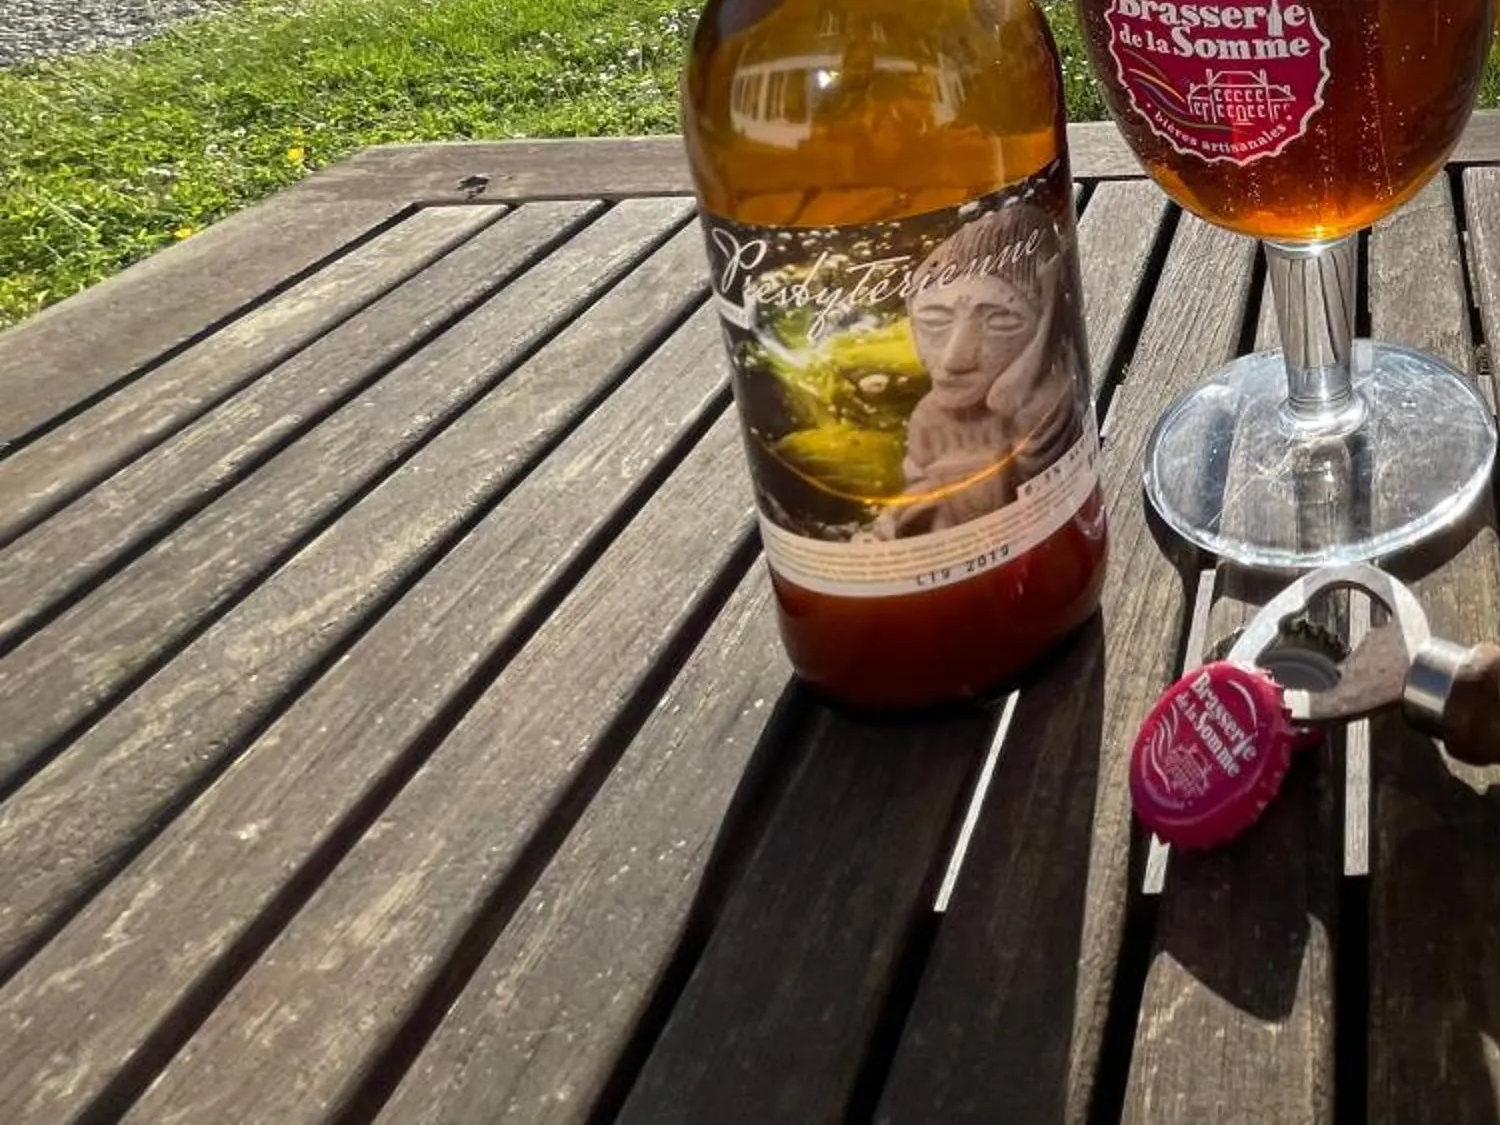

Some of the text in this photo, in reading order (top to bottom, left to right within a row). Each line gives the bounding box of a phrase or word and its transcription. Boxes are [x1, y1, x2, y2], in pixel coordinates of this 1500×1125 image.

[1120, 23, 1310, 59] de la Somme
[1201, 123, 1287, 154] artisanales
